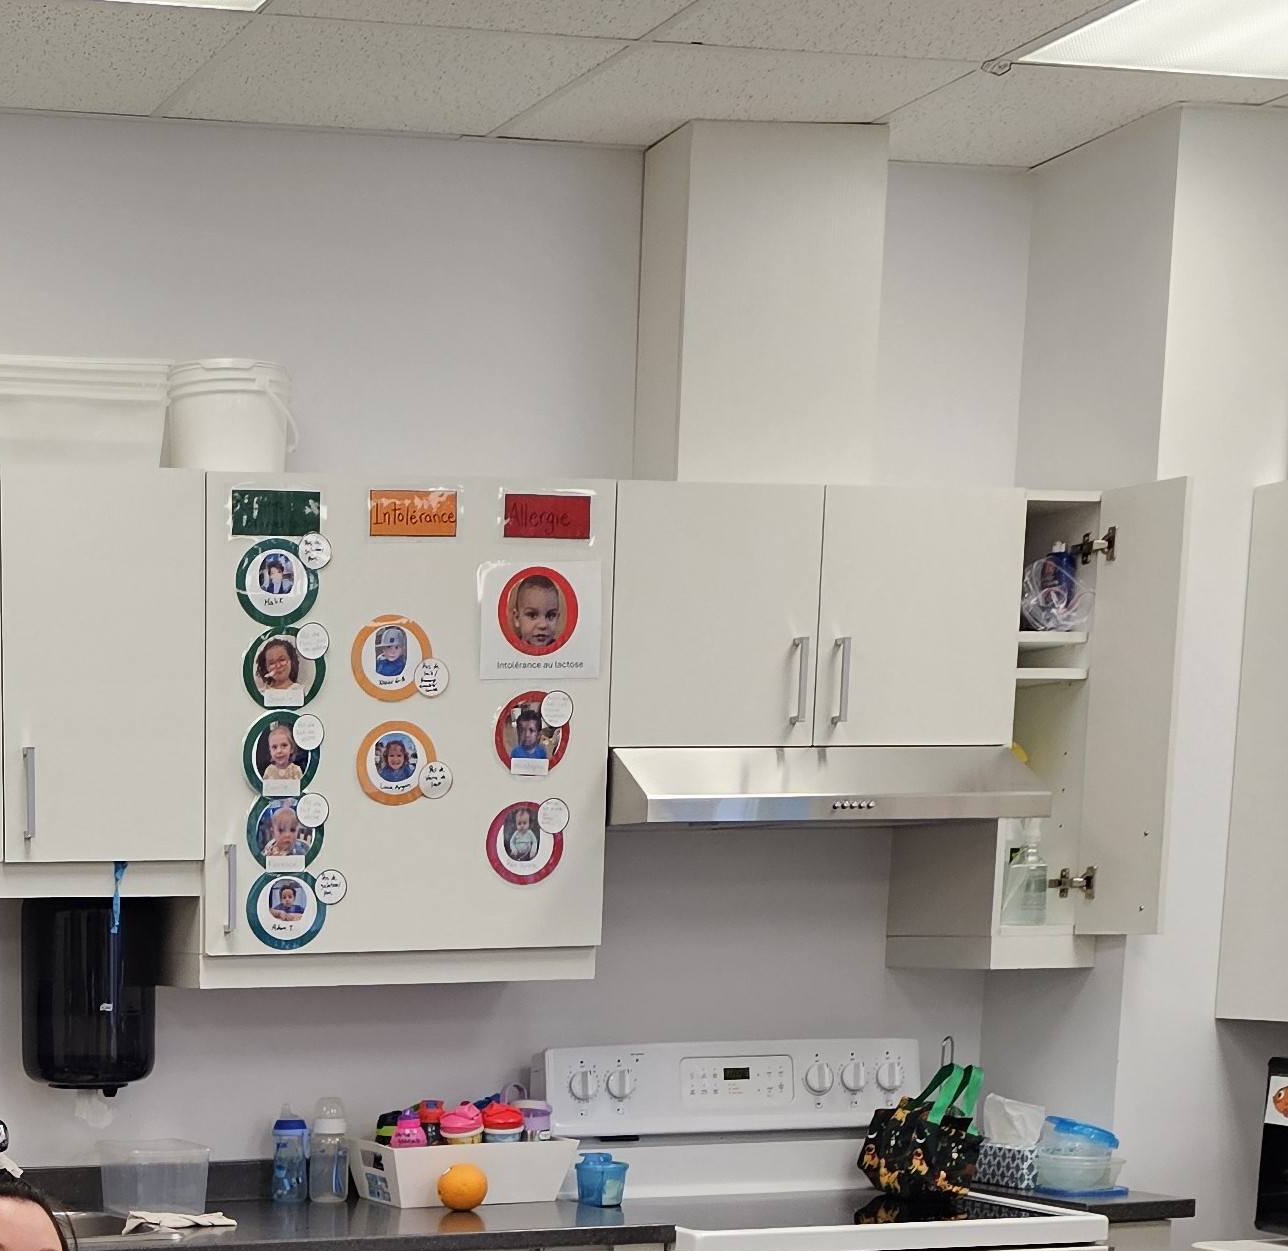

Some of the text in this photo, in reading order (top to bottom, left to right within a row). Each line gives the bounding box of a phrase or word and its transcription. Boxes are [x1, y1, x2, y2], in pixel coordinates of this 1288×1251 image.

[373, 501, 456, 525] Intolérance
[511, 503, 571, 535] Allergie
[496, 661, 542, 670] Intolérance
[554, 660, 584, 669] lactose
